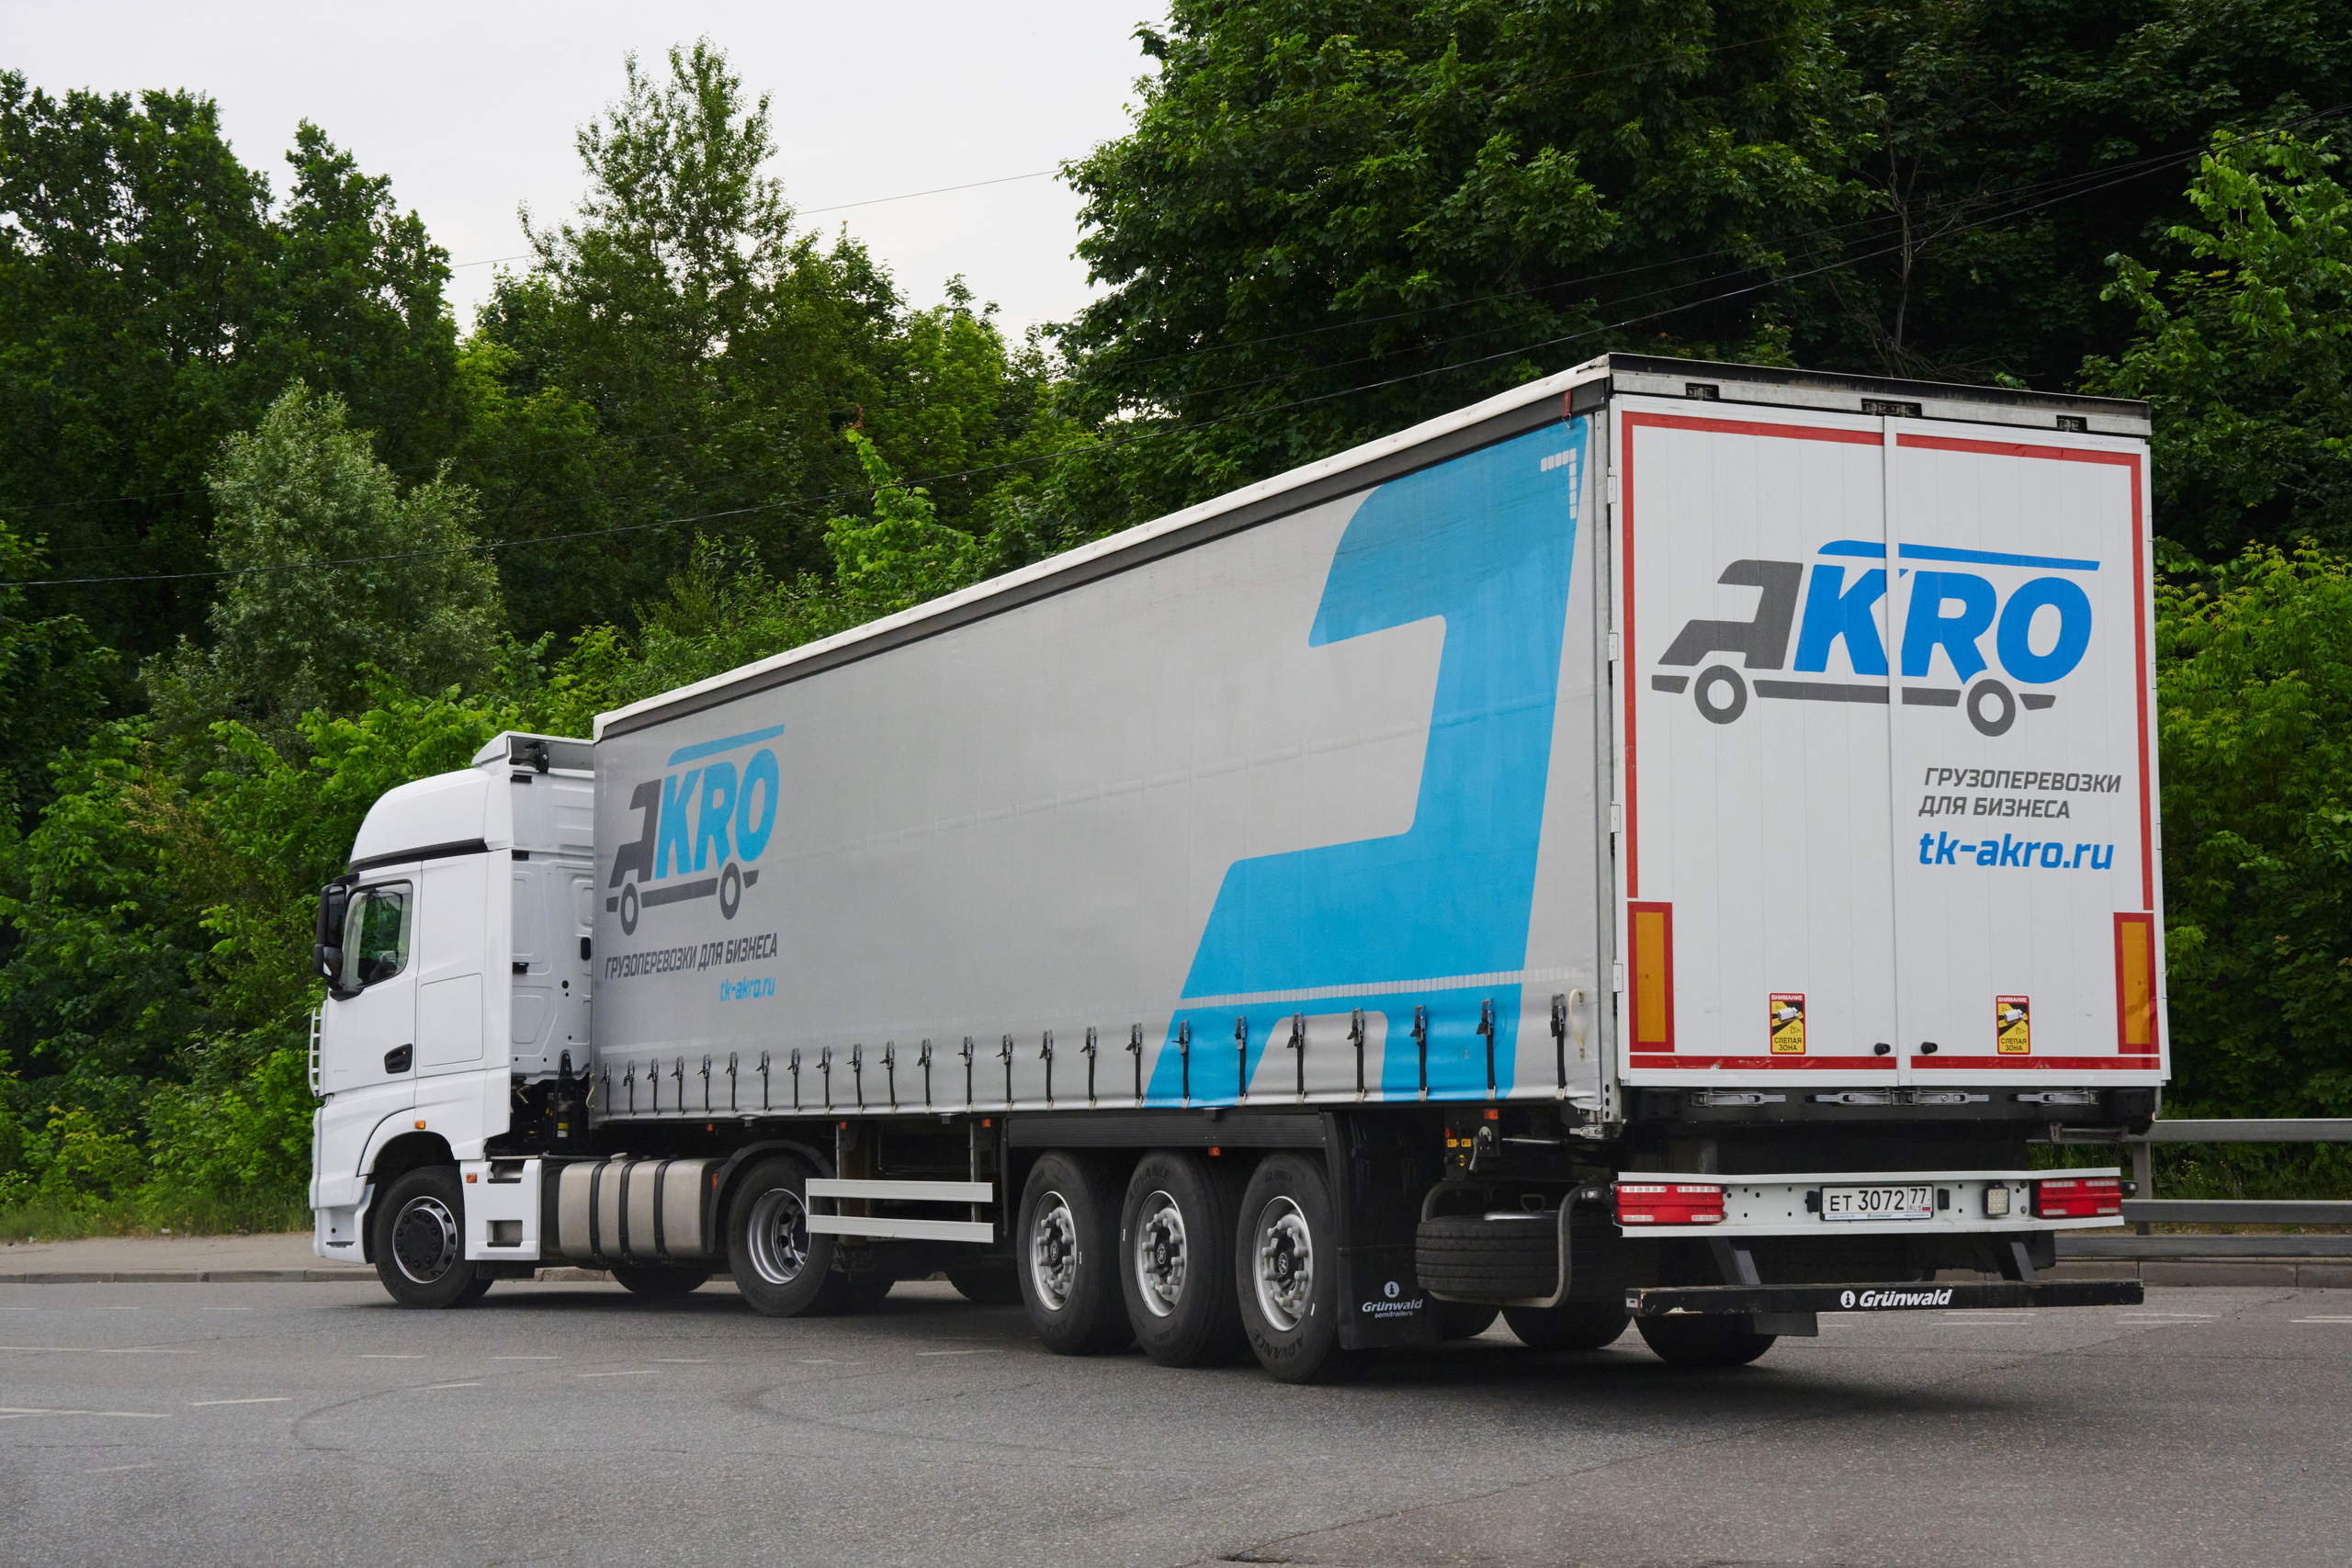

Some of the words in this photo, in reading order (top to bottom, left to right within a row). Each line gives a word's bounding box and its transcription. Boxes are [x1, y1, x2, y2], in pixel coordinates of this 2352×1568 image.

[1924, 767, 2121, 793] ГРУЗОПЕРЕВОЗКИ
[1917, 795, 1967, 817] ДЛЯ
[1973, 797, 2070, 818] БИЗНЕСА
[1919, 831, 2114, 870] tk-akro.ru
[605, 945, 697, 979] ГРУЗОПЕРЕВОЗКИ
[697, 942, 724, 972] ДЛЯ
[725, 932, 777, 964] БИЗНЕСА
[719, 976, 775, 1002] tk-akro.ru
[1858, 1190, 1905, 1212] 3072
[1362, 1299, 1423, 1313] Grünwald
[1859, 1289, 1953, 1307] Grünwald
[1374, 1310, 1413, 1319] semitrailers
[1252, 1328, 1304, 1359] ADVANCE
